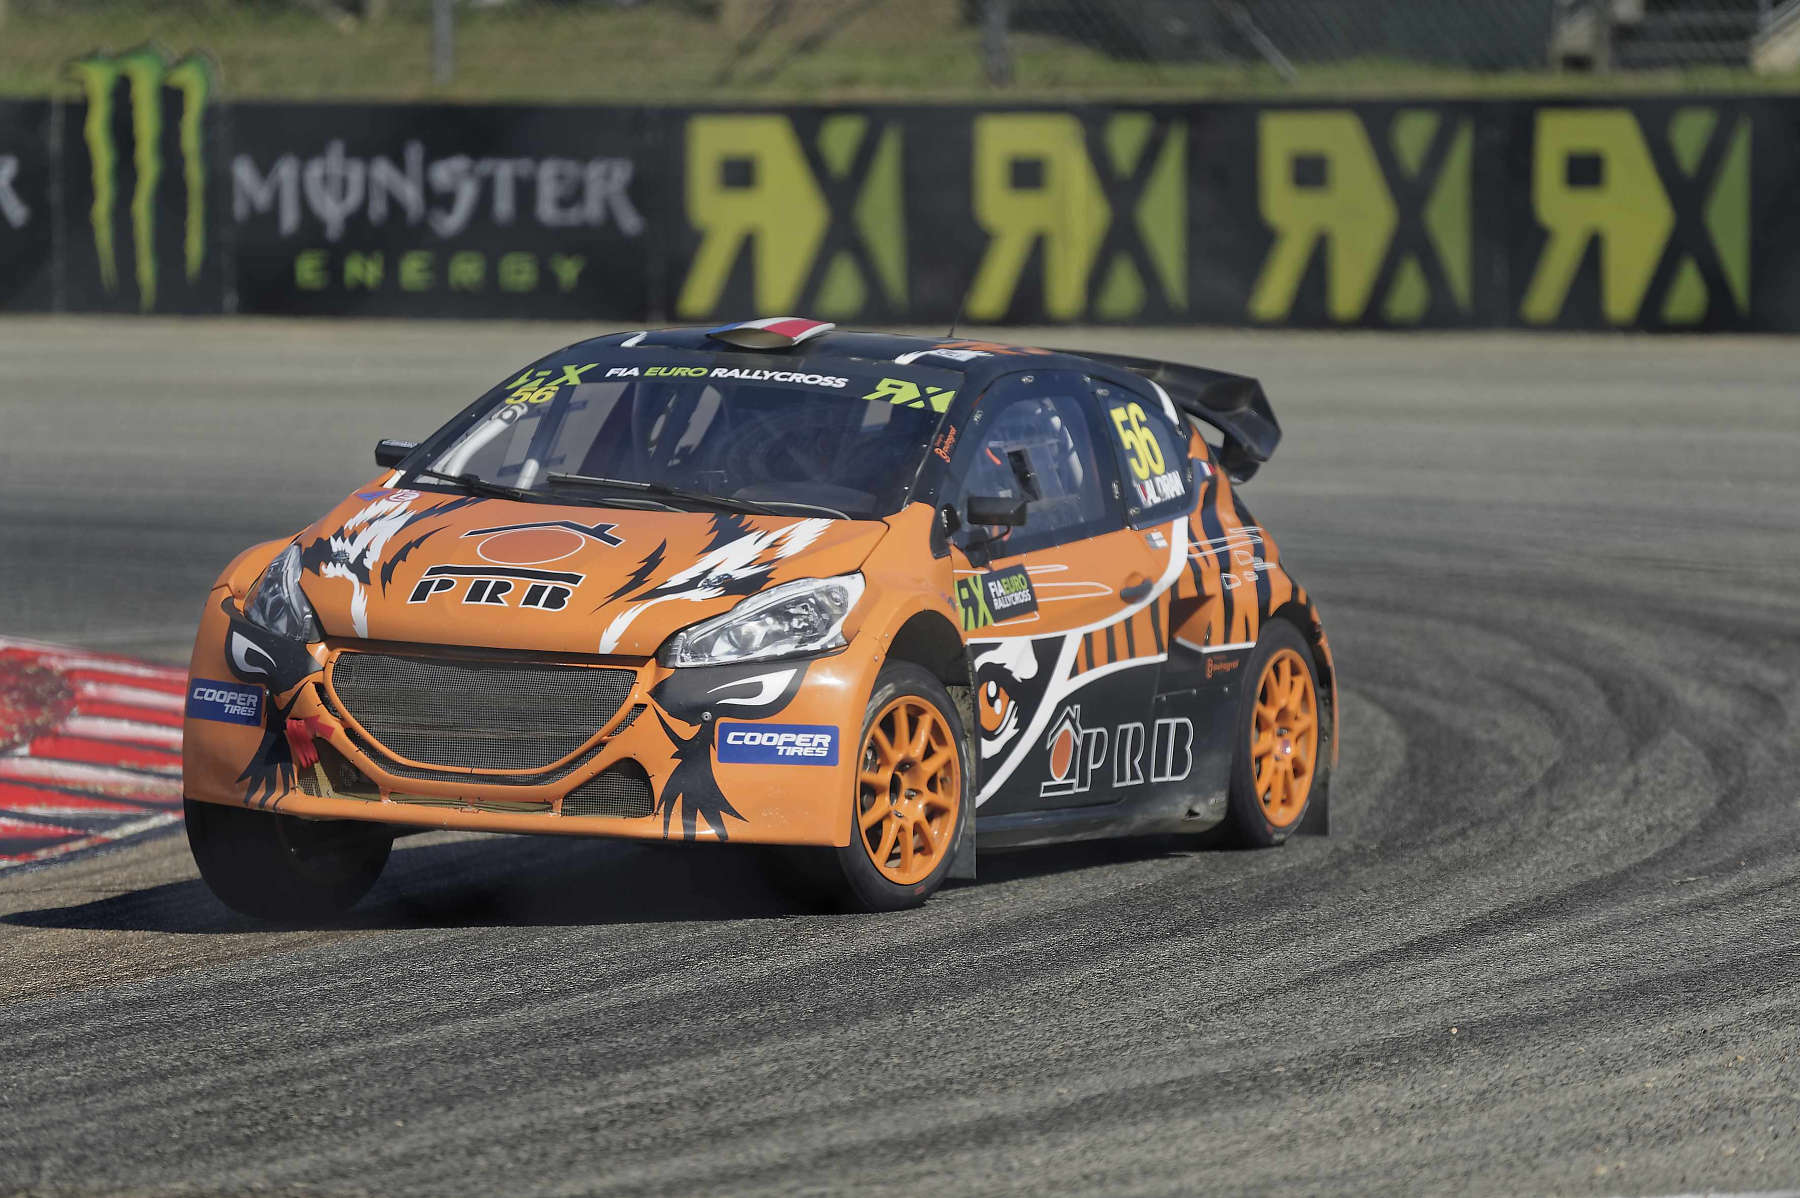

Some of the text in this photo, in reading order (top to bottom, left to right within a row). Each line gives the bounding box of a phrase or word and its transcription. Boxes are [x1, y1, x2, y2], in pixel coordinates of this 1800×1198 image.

[231, 140, 645, 240] MONSTER
[294, 249, 586, 291] ENERGY
[605, 366, 849, 389] FIA EURO RALLYCROSS
[505, 385, 559, 404] 56
[1110, 402, 1166, 480] 56
[407, 578, 573, 613] PRB
[993, 589, 1032, 611] RALLYCROSS
[193, 687, 258, 707] COOPER
[224, 703, 256, 717] TIRES
[726, 731, 832, 748] COOPER
[776, 746, 830, 757] TIRES
[1074, 717, 1194, 792] PRB
